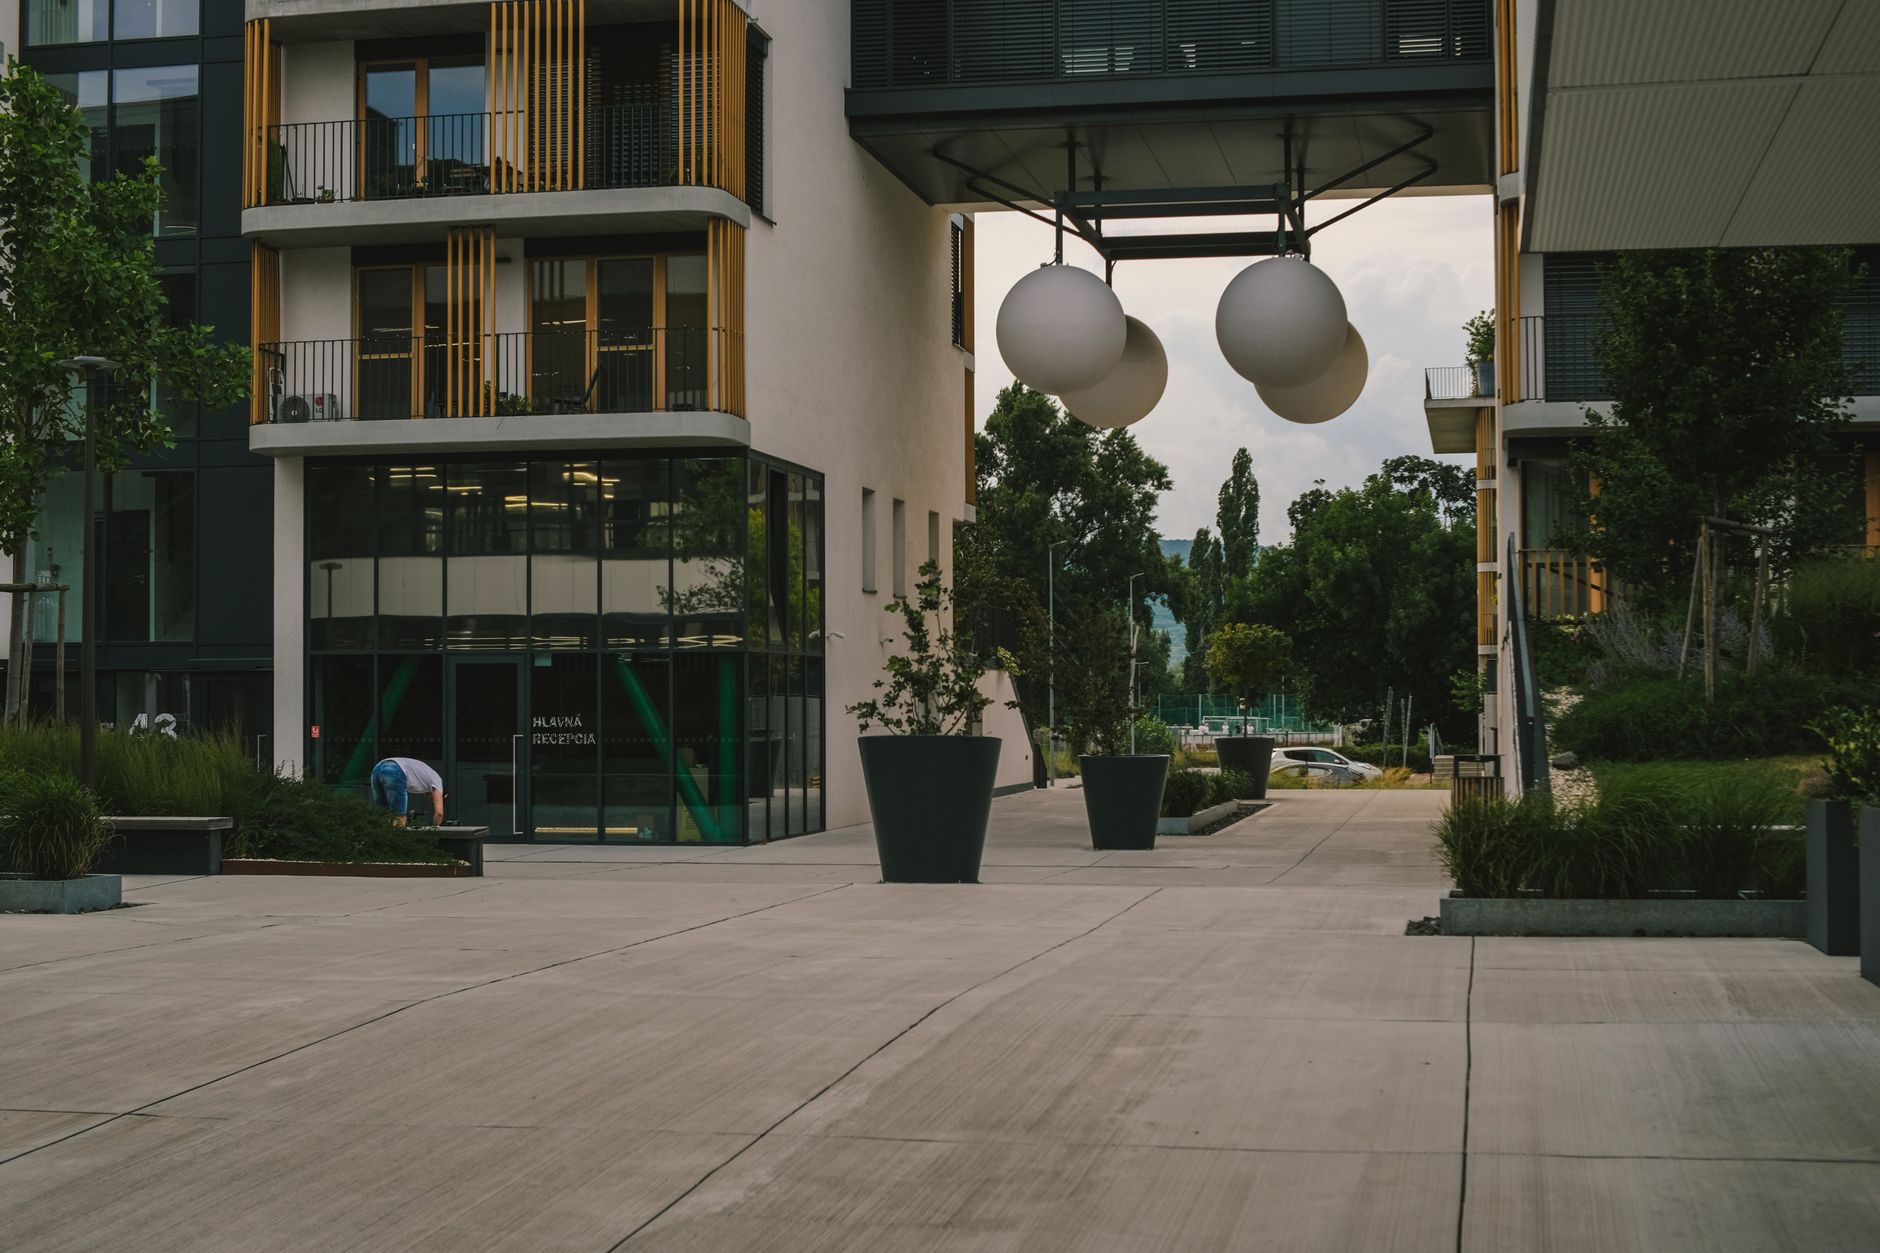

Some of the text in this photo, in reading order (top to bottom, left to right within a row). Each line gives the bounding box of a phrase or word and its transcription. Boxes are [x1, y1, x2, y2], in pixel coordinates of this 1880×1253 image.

[128, 713, 178, 741] 43
[532, 713, 582, 728] HLAVNÁ
[532, 733, 596, 745] RECEPCIA
